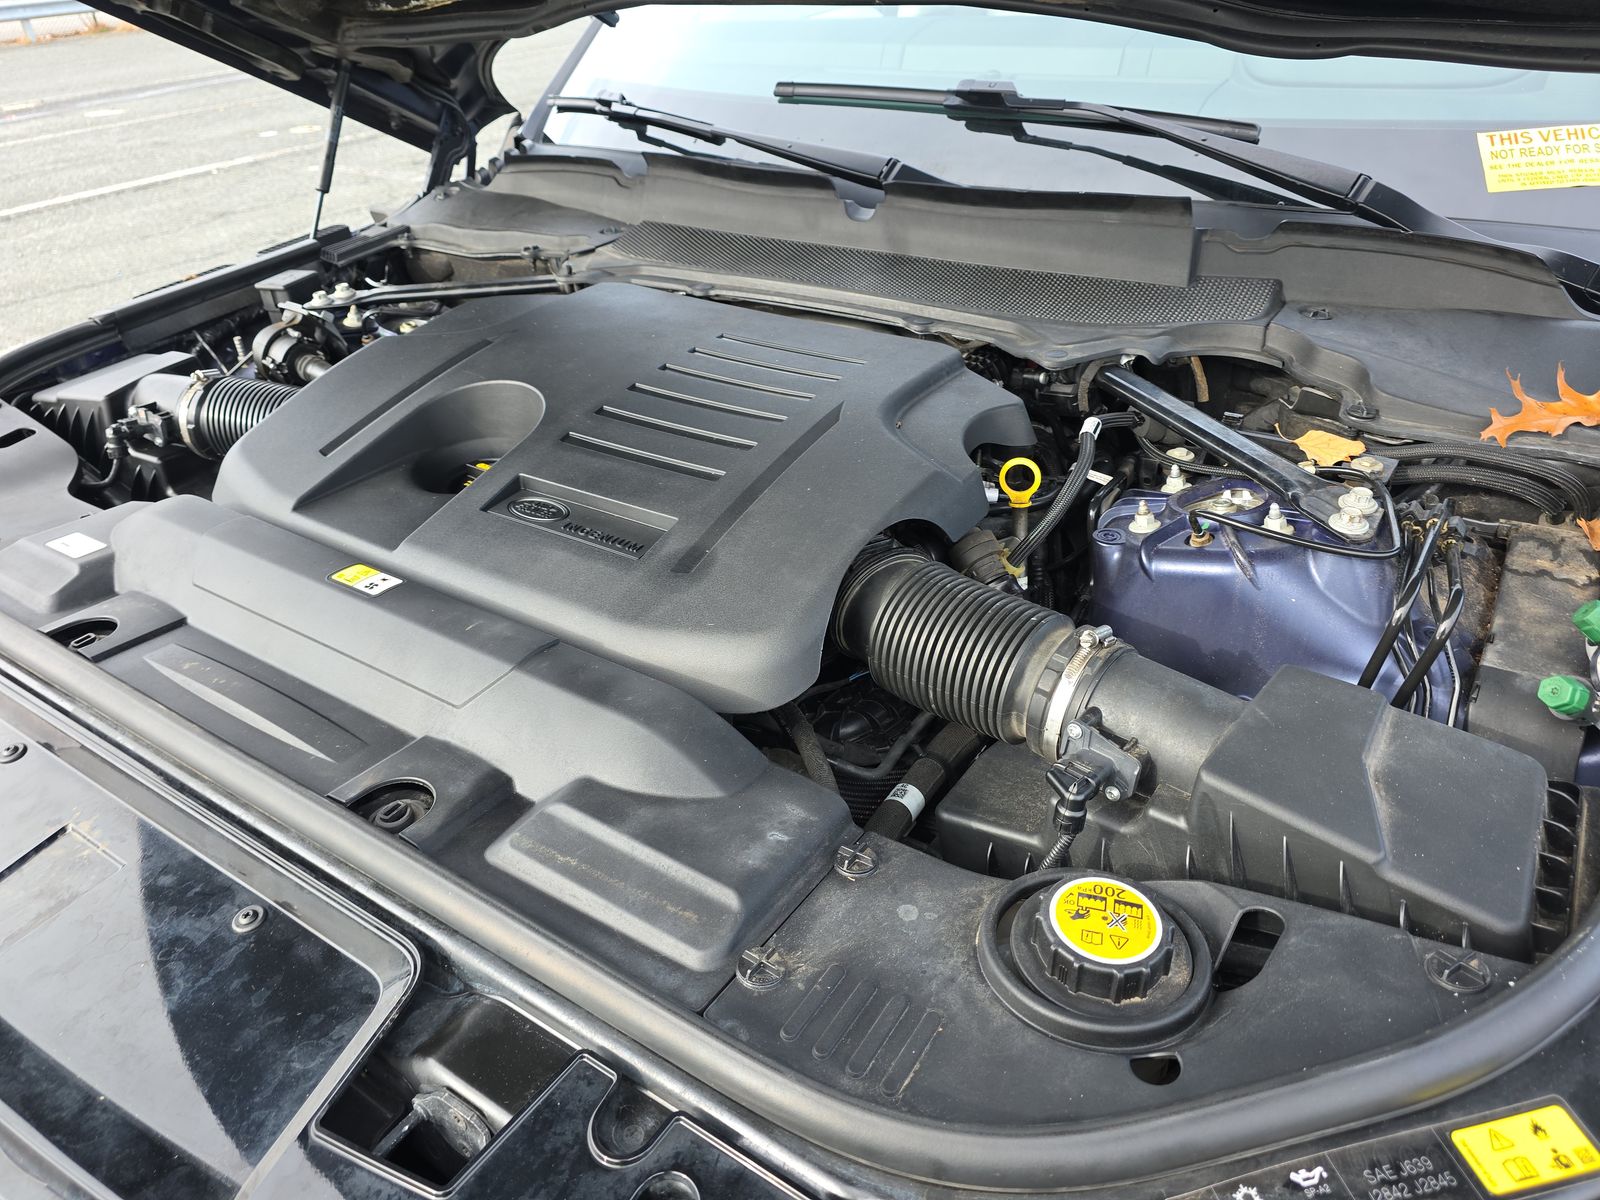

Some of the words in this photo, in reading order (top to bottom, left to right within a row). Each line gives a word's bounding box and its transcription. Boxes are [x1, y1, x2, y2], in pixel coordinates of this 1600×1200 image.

[1486, 131, 1533, 147] THIS
[1538, 126, 1600, 142] VEHIC
[1490, 149, 1515, 160] NOT
[1520, 145, 1560, 157] READY
[1565, 143, 1591, 154] FOR
[561, 522, 645, 553] INGENIUM
[1093, 884, 1127, 900] 200
[1363, 1165, 1399, 1185] SAE
[1399, 1155, 1434, 1177] J639
[1414, 1171, 1458, 1196] J2845
